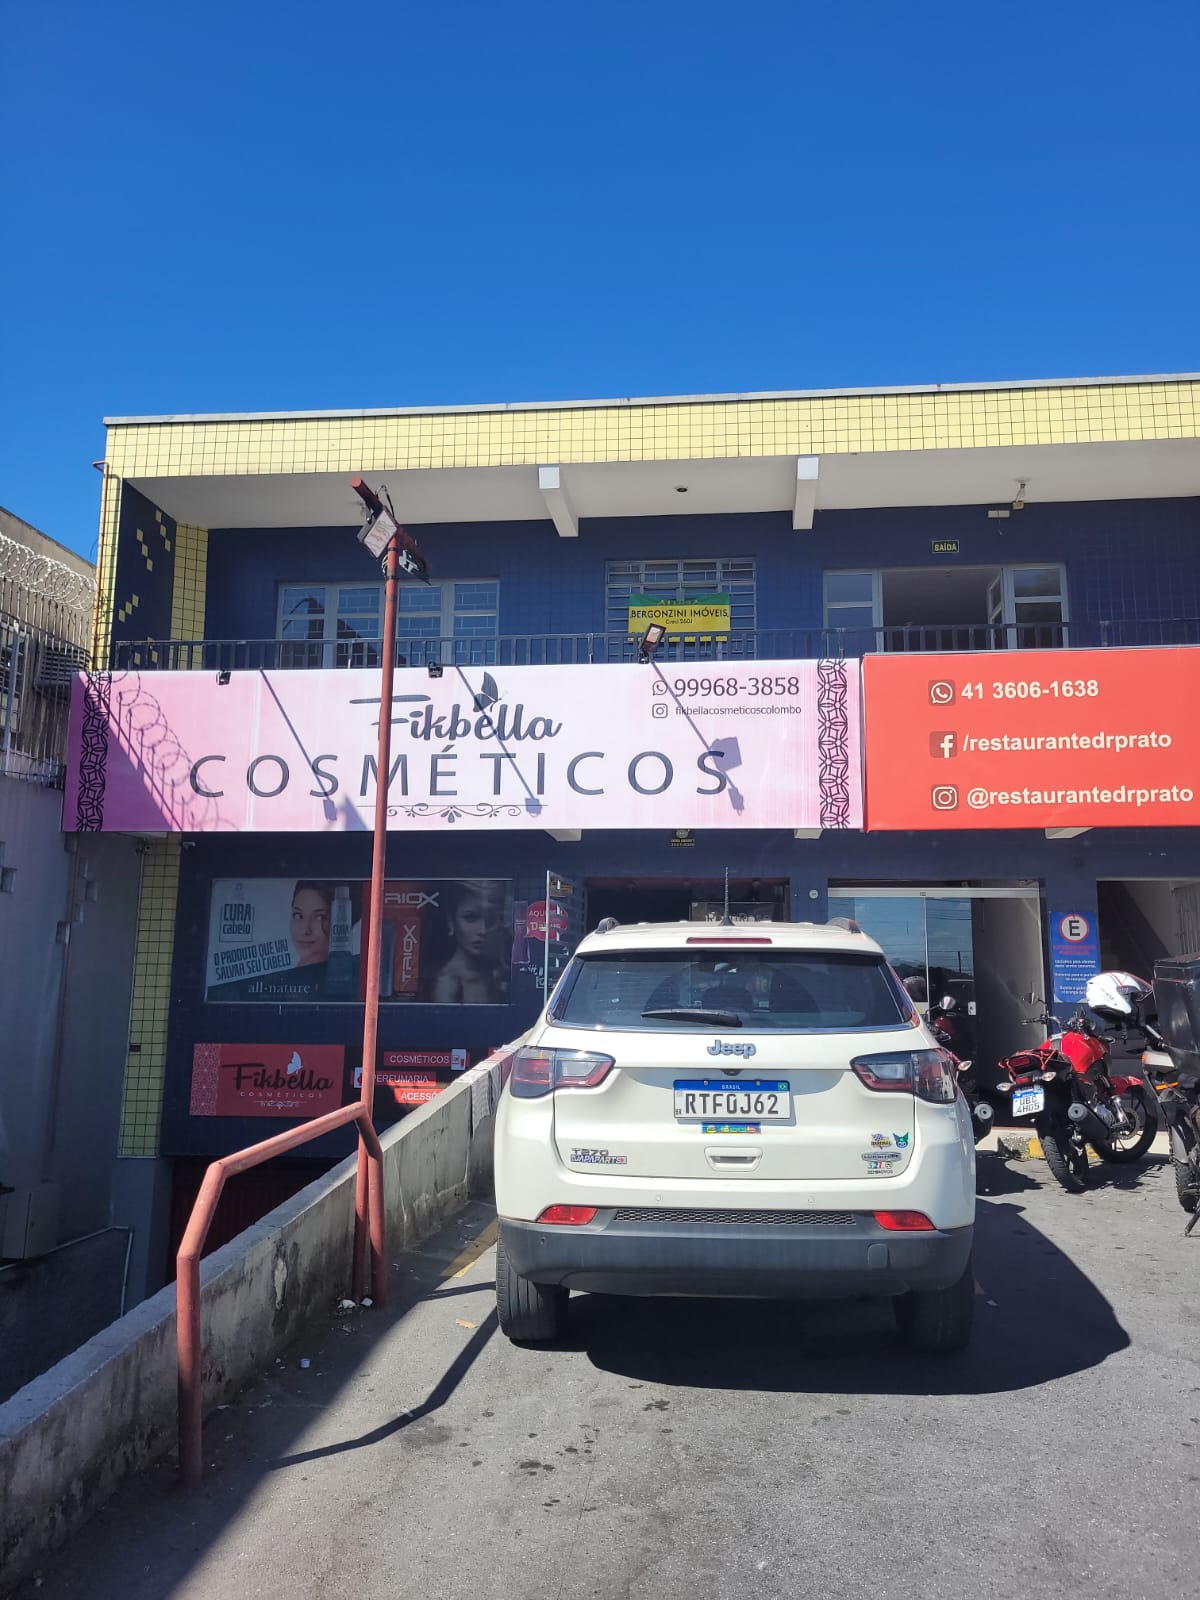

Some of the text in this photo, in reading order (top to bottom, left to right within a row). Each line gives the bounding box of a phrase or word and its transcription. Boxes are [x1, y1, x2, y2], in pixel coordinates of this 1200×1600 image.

[934, 543, 957, 551] SAÍDA
[631, 609, 687, 618] BERGONZINI
[674, 677, 800, 697] 99968-3858
[961, 680, 1099, 699] 41 3606-1638
[349, 694, 563, 741] Fikbella
[675, 705, 802, 715] fikbellacosmeticoscolombo
[962, 732, 1172, 752] /restaurantedrprato
[189, 745, 728, 798] COSMÉTICOS
[967, 786, 1194, 809] @restaurantedrprato
[384, 892, 440, 909] RIOX
[224, 903, 252, 921] CURA
[222, 920, 251, 935] cabelo
[1069, 920, 1080, 936] E
[214, 938, 289, 966] O PRODUTO QUE VAI
[402, 924, 418, 982] TRIOX
[246, 958, 262, 974] SEU
[262, 953, 292, 971] CABELO
[390, 1054, 450, 1064] COSMÉTICOS
[706, 1039, 757, 1060] Jeep
[221, 1062, 334, 1090] Fikbella
